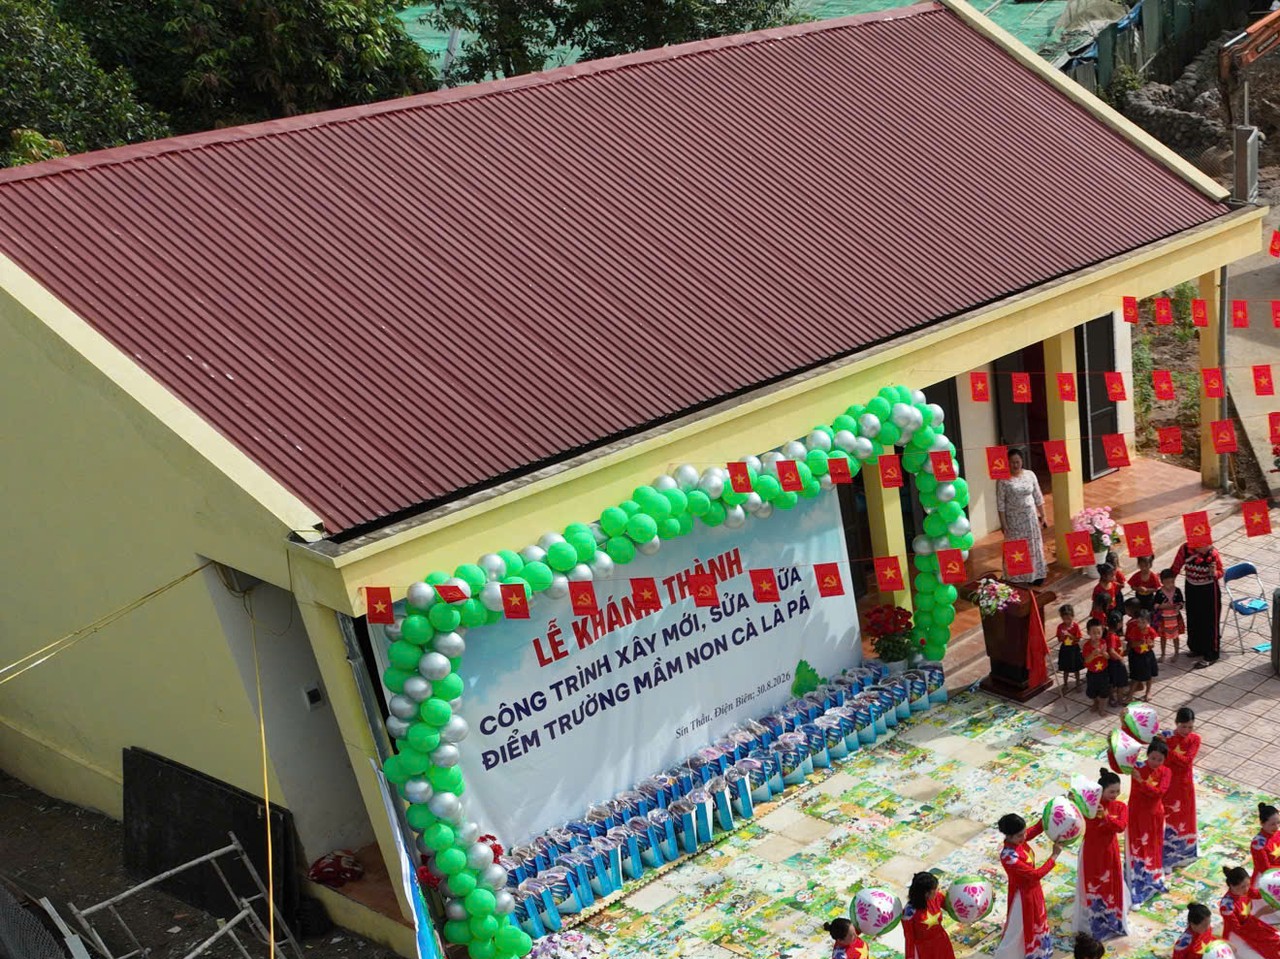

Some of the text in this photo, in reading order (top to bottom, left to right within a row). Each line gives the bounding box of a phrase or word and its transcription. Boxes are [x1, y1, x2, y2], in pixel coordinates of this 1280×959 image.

[479, 567, 802, 735] CÔNG TRÌNH XÂY MỚI, SỬA ỮA
[482, 590, 810, 771] ĐIỂM TRƯỜNG MẦM NON CÀ LÀ PÁ
[532, 618, 569, 668] LỄ
[714, 702, 734, 718] Điện
